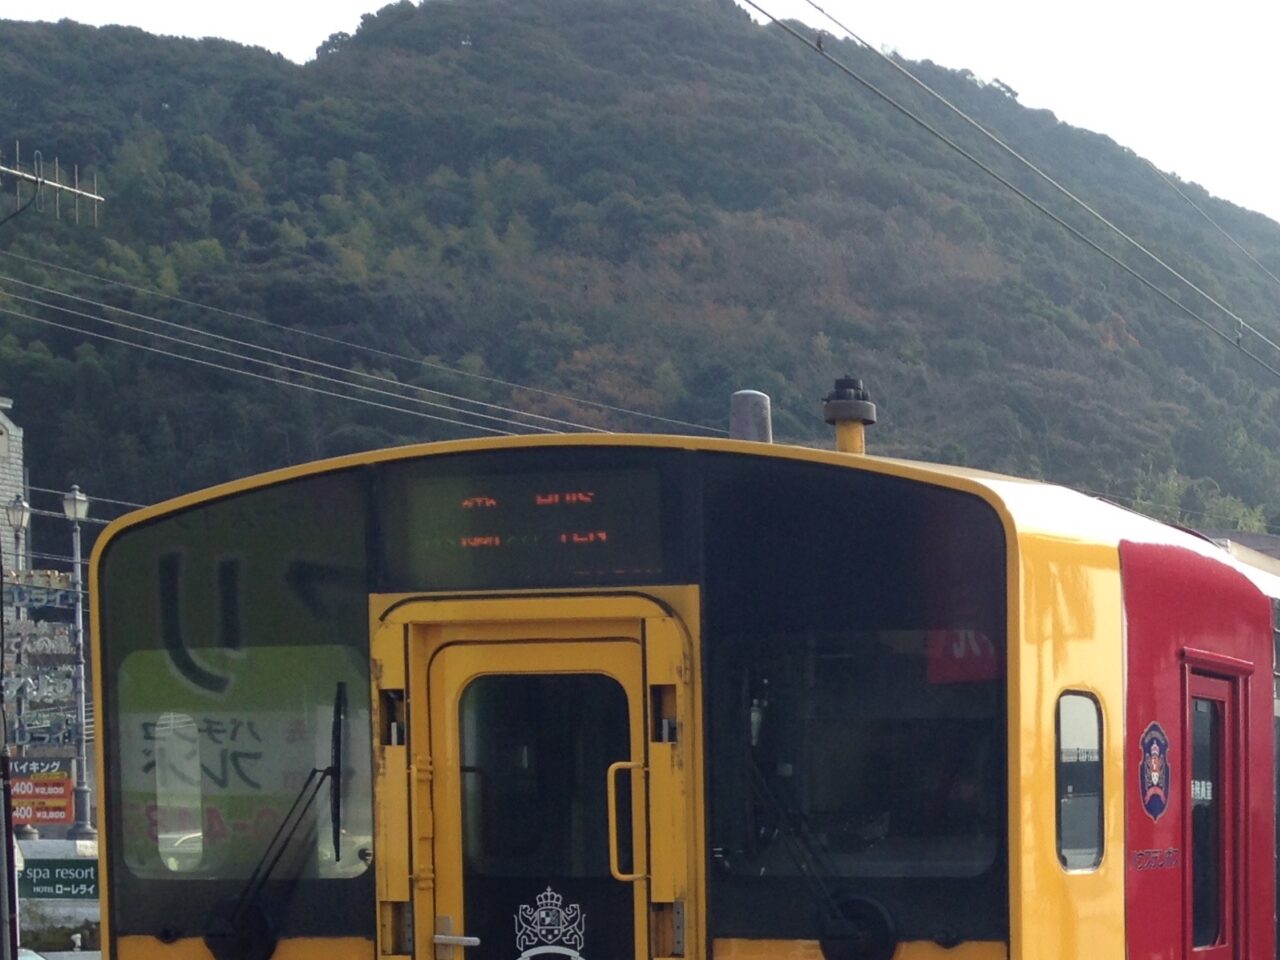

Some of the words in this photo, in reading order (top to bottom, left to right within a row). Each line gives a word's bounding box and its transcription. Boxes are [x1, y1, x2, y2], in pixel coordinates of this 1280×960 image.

[26, 867, 50, 883] spa
[55, 866, 95, 880] resort
[55, 884, 95, 895] ローレライ
